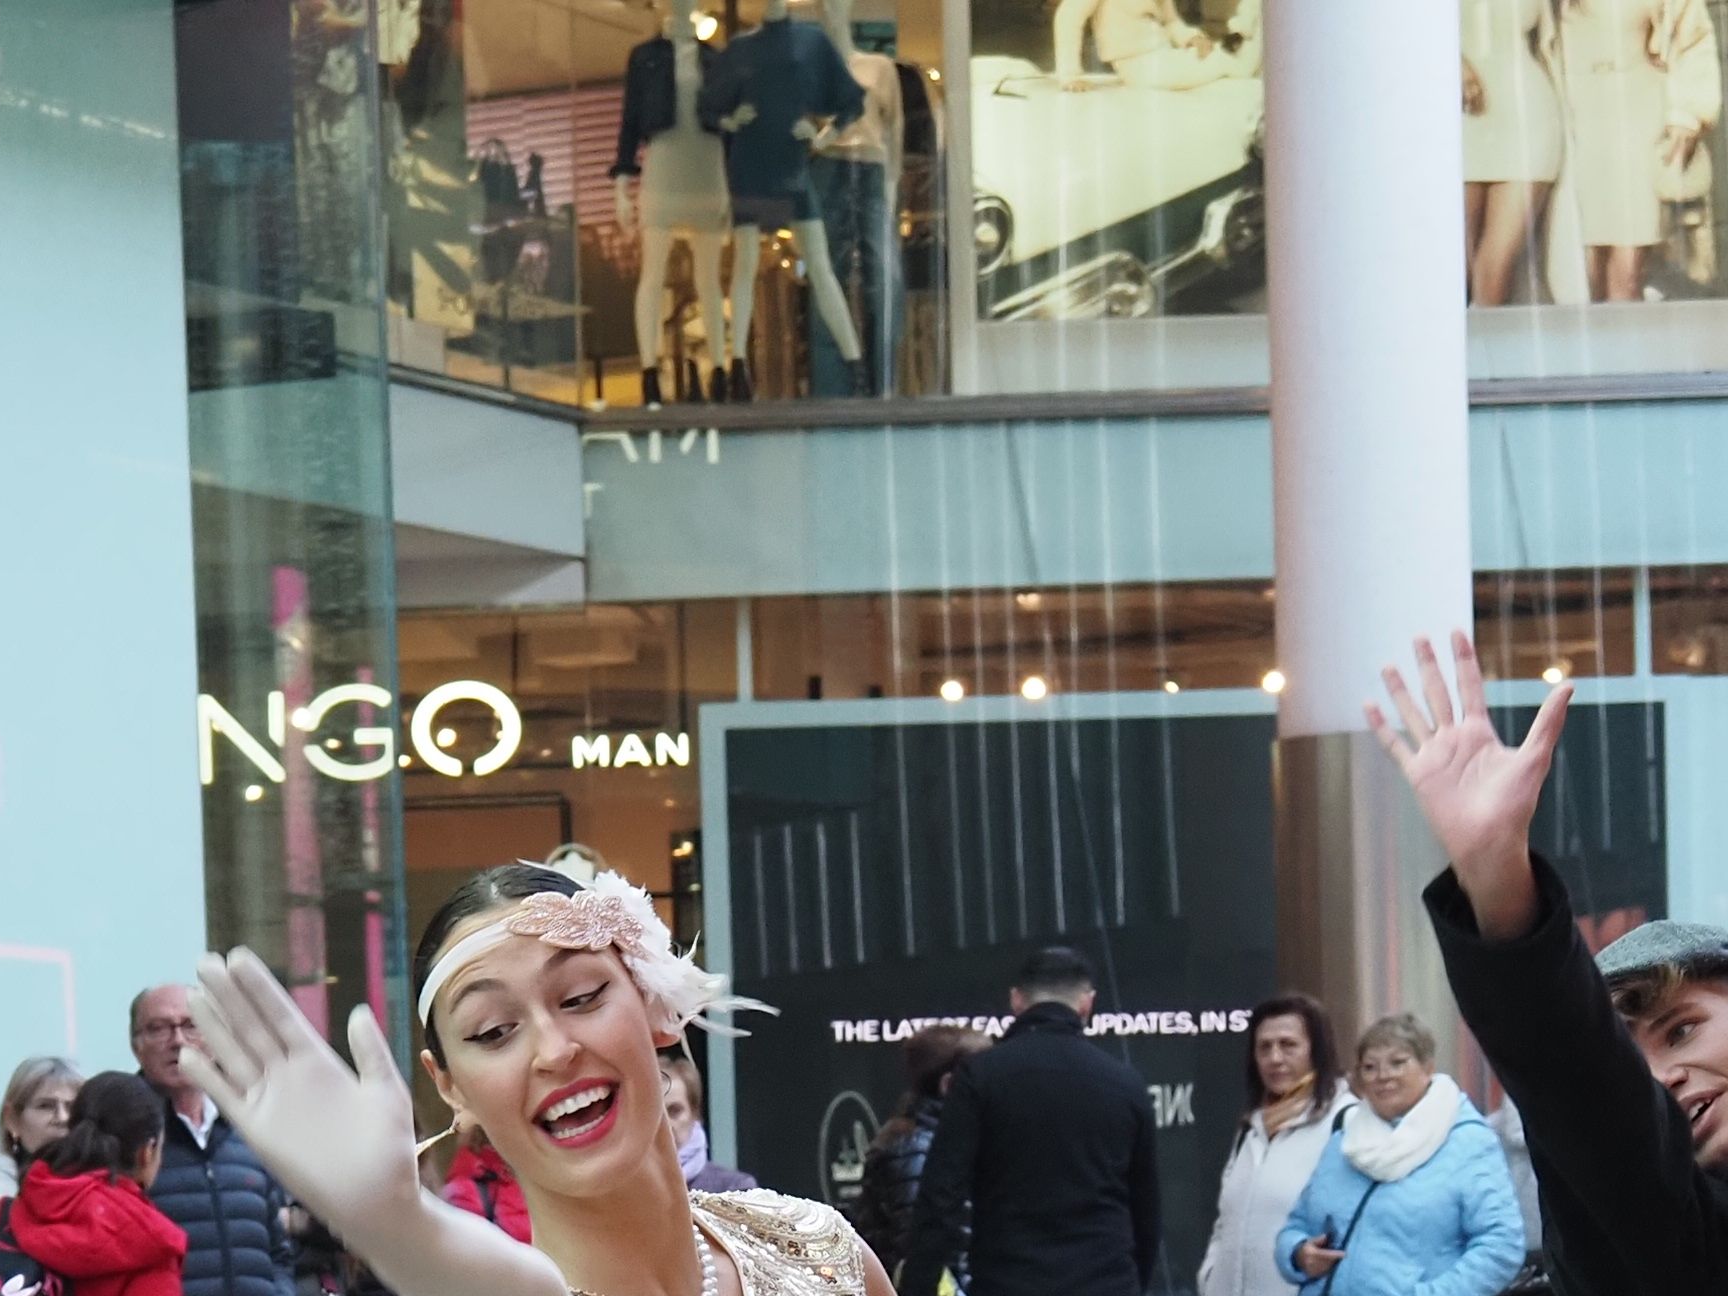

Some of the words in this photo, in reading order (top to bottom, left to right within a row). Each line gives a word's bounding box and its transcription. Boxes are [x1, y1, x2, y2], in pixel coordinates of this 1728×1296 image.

[571, 732, 691, 770] MAN
[831, 1019, 880, 1042] THE
[1200, 1010, 1226, 1033] IN
[1229, 1009, 1253, 1033] S
